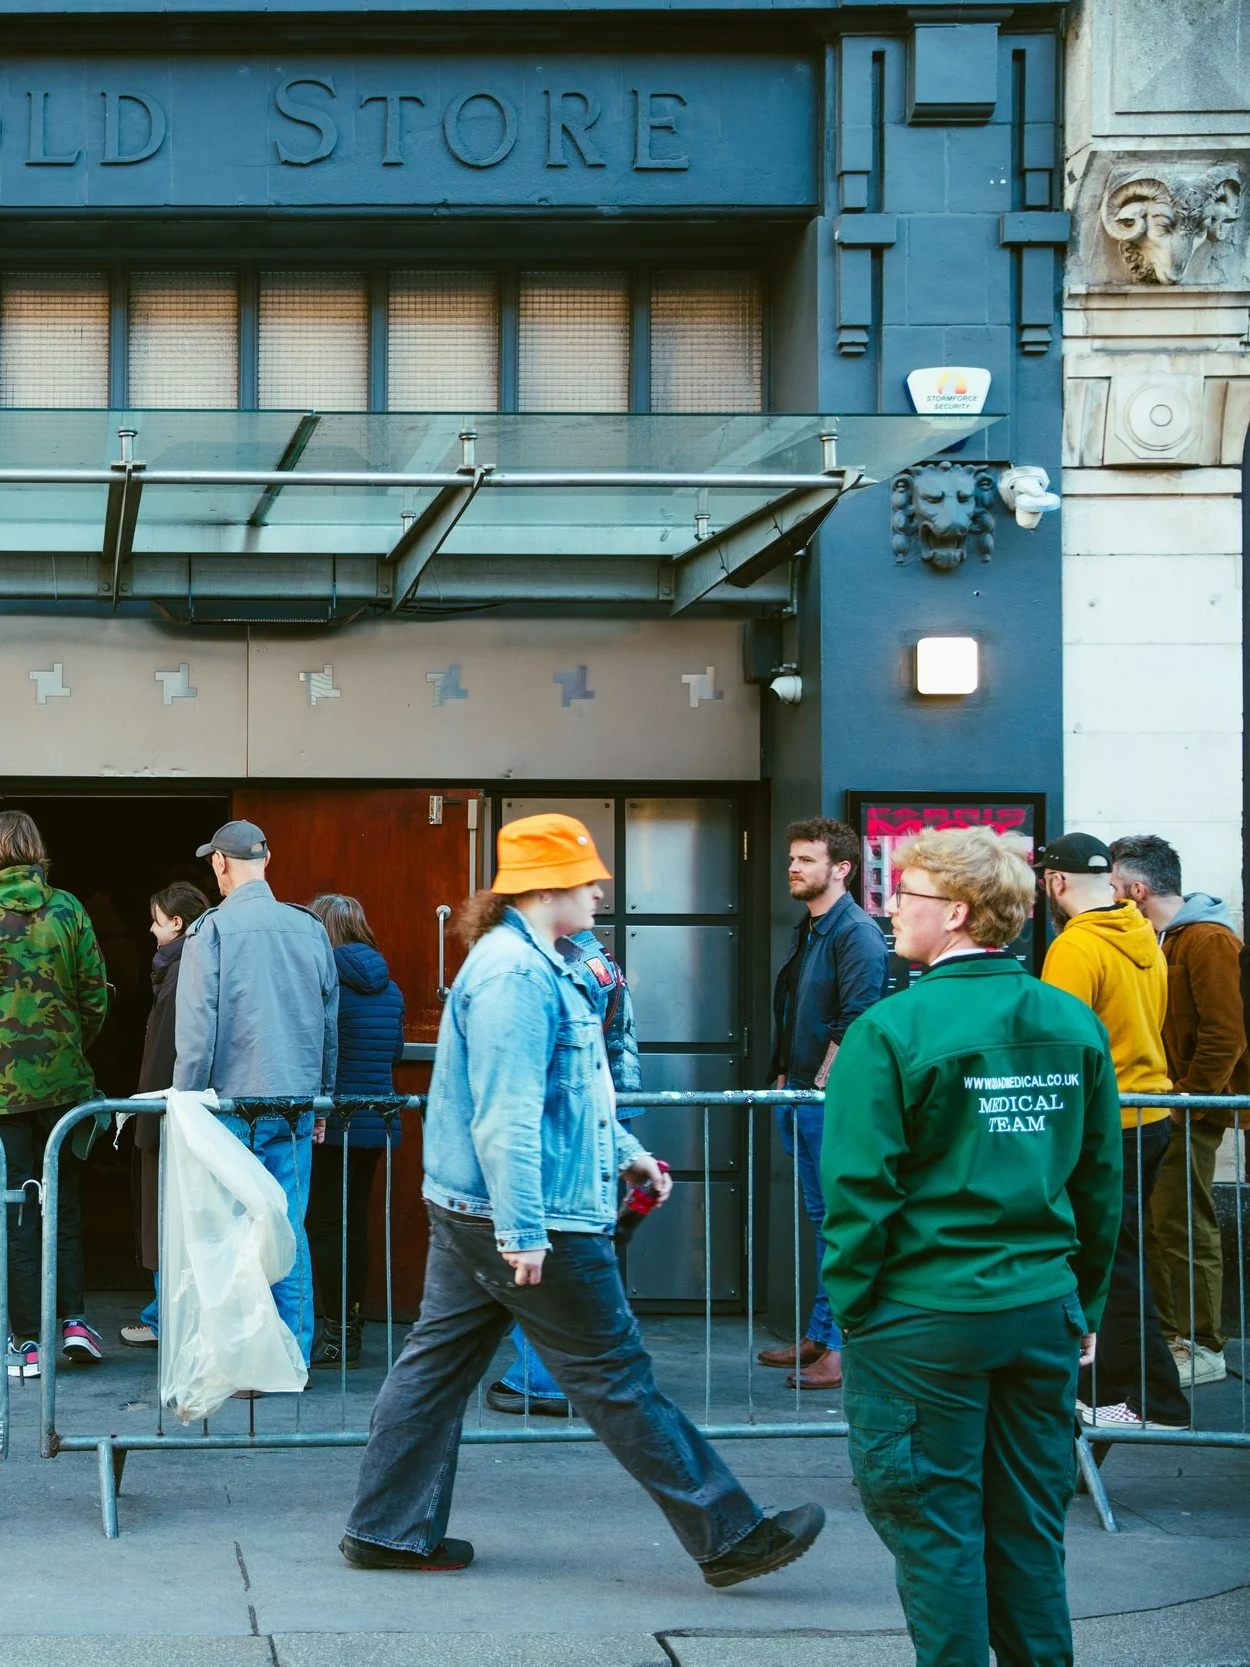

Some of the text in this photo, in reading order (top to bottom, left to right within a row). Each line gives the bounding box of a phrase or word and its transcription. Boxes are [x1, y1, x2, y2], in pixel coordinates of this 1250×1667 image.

[274, 74, 689, 171] STORE
[978, 1094, 1064, 1113] MEDICAL
[988, 1115, 1046, 1132] TEAM
